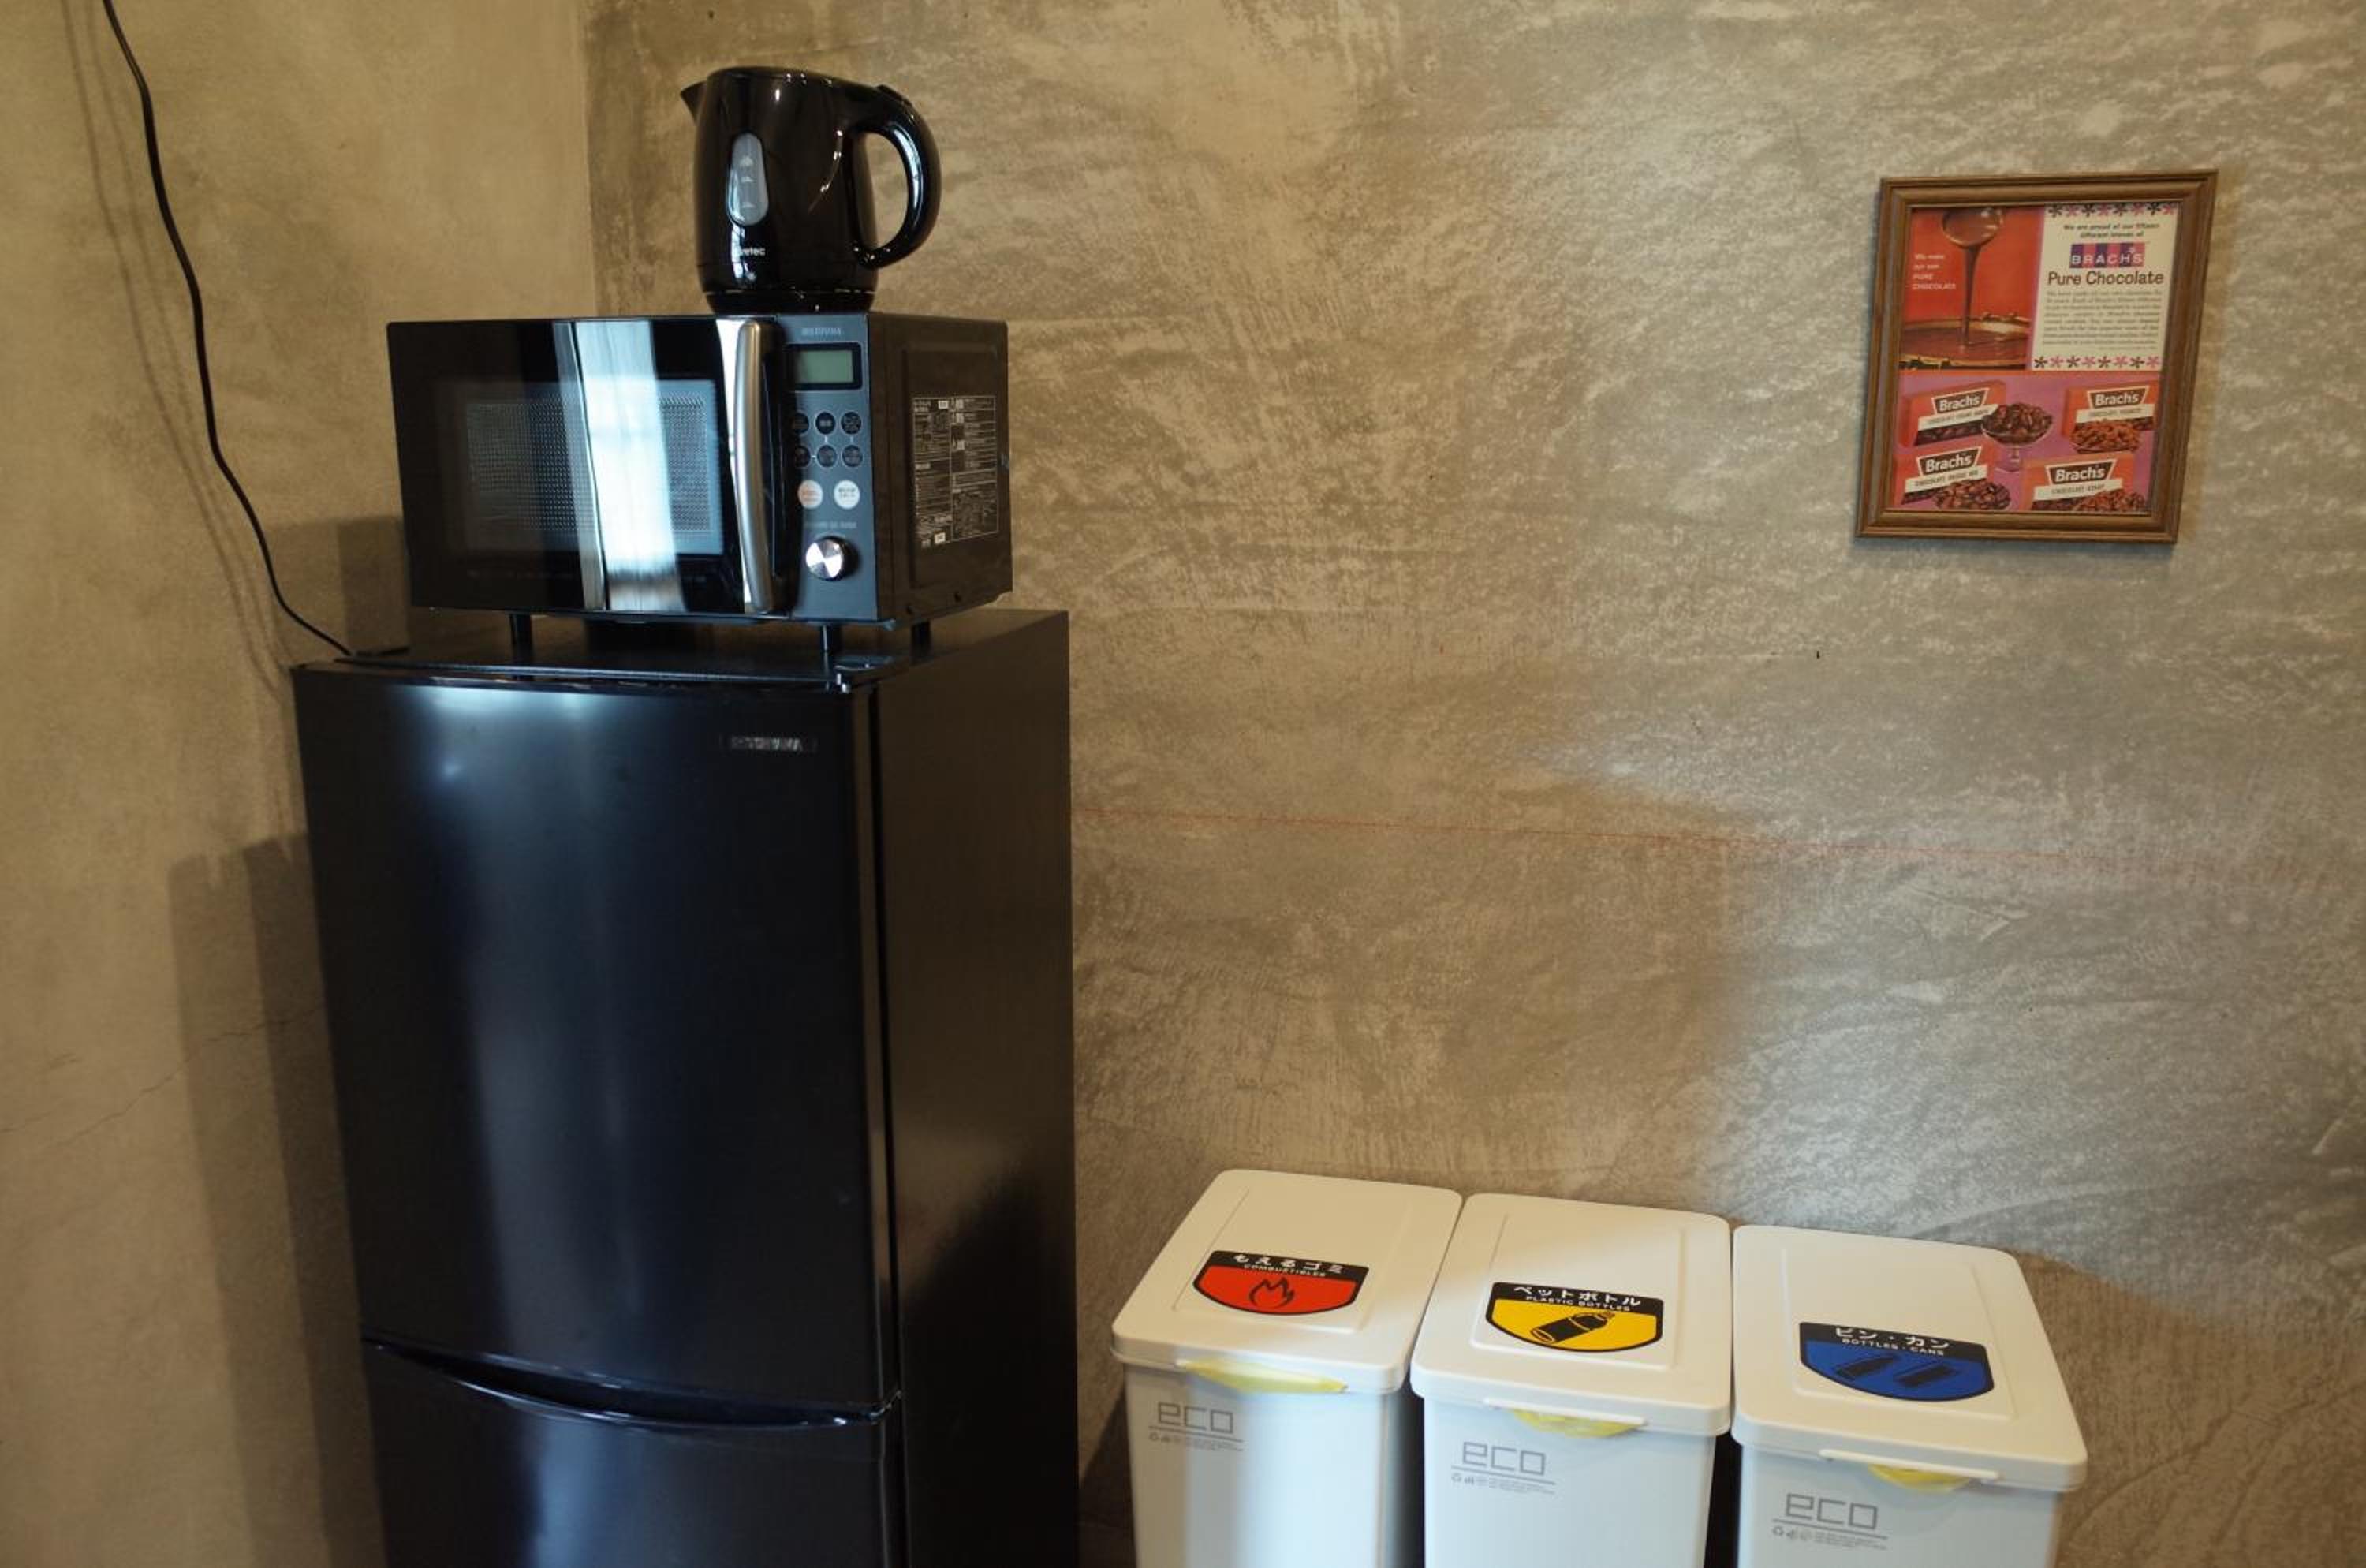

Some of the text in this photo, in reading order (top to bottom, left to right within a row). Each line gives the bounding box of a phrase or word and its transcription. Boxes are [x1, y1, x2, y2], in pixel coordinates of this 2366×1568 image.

[2048, 271, 2164, 286] Pure Chocolate
[1233, 1253, 1344, 1274] もえるゴミ
[1244, 1264, 1327, 1277] COMBUSTIBLES
[1525, 1295, 1631, 1312] PLASTIC BOTTLES
[1157, 1402, 1234, 1435] eco
[1463, 1443, 1547, 1477] eco
[1785, 1492, 1878, 1530] eco
